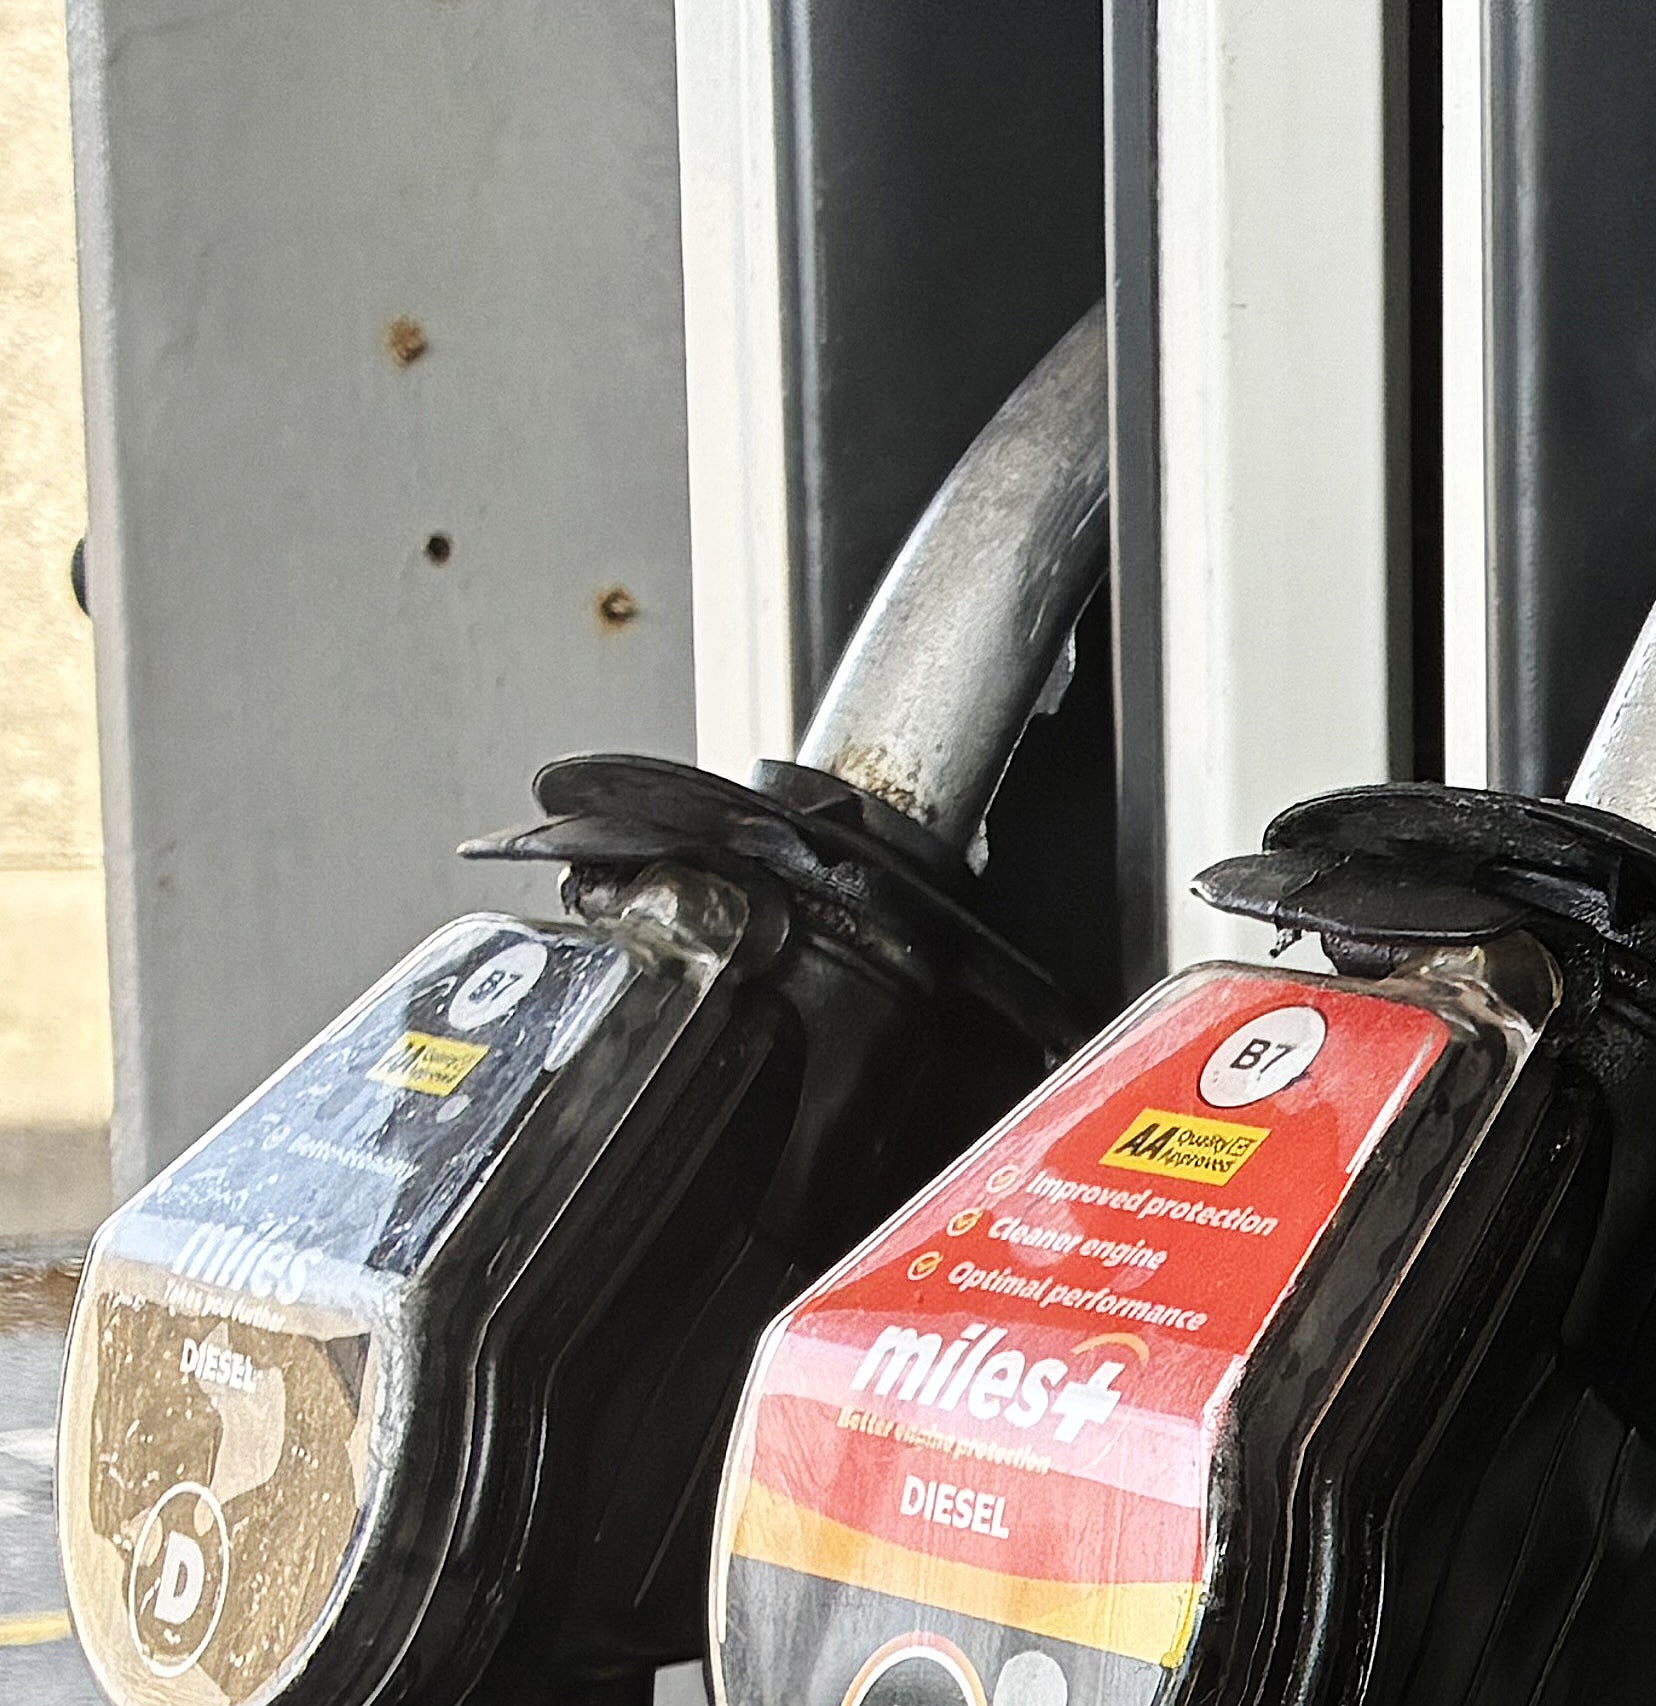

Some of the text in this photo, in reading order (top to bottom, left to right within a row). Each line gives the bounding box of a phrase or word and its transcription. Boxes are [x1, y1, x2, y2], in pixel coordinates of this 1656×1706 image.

[1229, 1037, 1297, 1081] B7
[1113, 1122, 1181, 1161] AA
[1026, 1171, 1280, 1237] Improved protection
[988, 1216, 1168, 1271] Cleaner engine
[947, 1261, 1208, 1332] Optimal performance
[179, 1338, 257, 1394] DIESEL
[900, 1474, 1010, 1540] DIESEL
[154, 1530, 205, 1625] D
